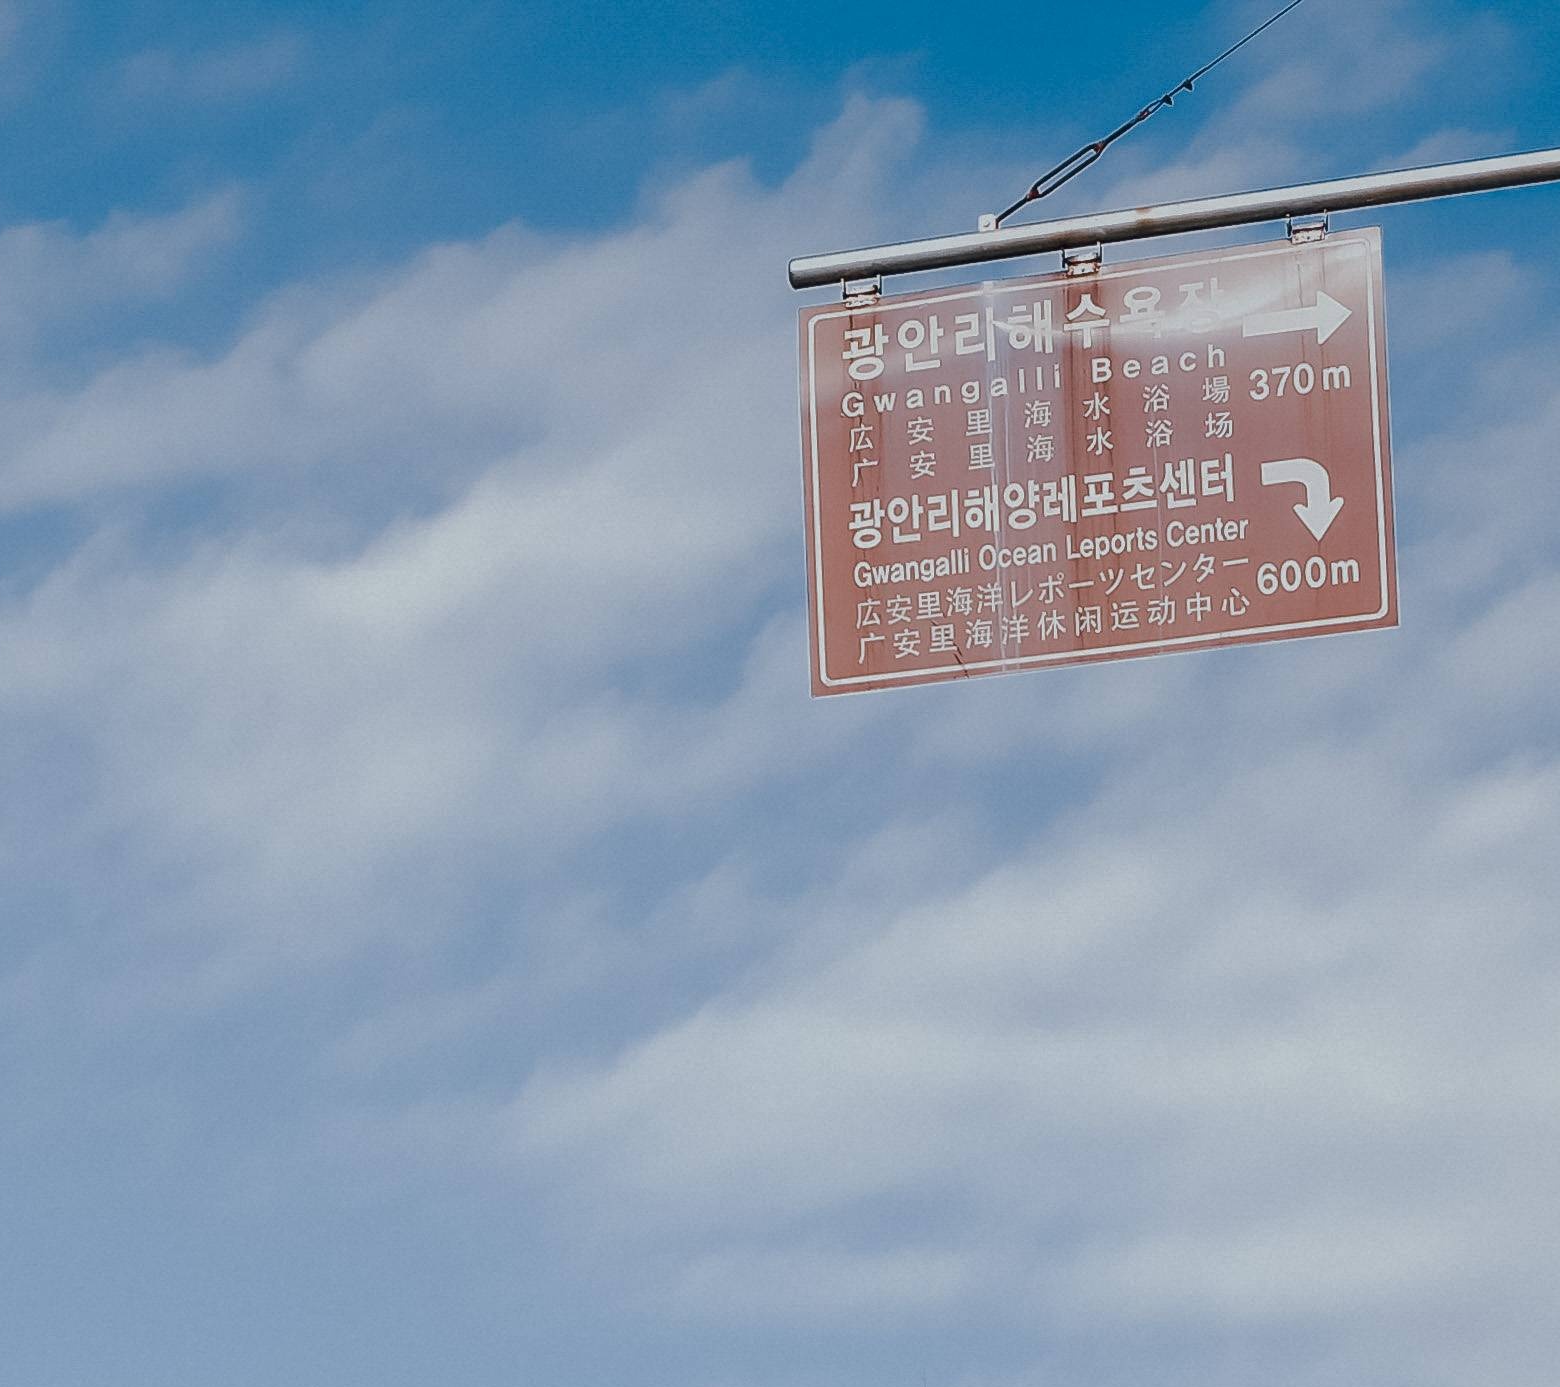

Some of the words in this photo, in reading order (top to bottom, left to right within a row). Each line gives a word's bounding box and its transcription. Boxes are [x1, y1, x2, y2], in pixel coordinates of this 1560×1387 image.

[840, 275, 1231, 382] 광안리해수욕장
[840, 364, 1062, 419] Gwangalli
[1091, 343, 1226, 385] Beach
[1248, 362, 1352, 402] 370m
[851, 410, 1233, 488] 广安里海水浴场
[847, 453, 1235, 549] 광안리해양레포츠센터
[853, 550, 971, 589] Gwangalli
[979, 538, 1057, 571] Ocean
[1066, 528, 1158, 567] Leports
[1166, 516, 1248, 549] Center
[1256, 555, 1361, 596] 600m
[858, 587, 1251, 664] 广安里海洋休闲运动中心
